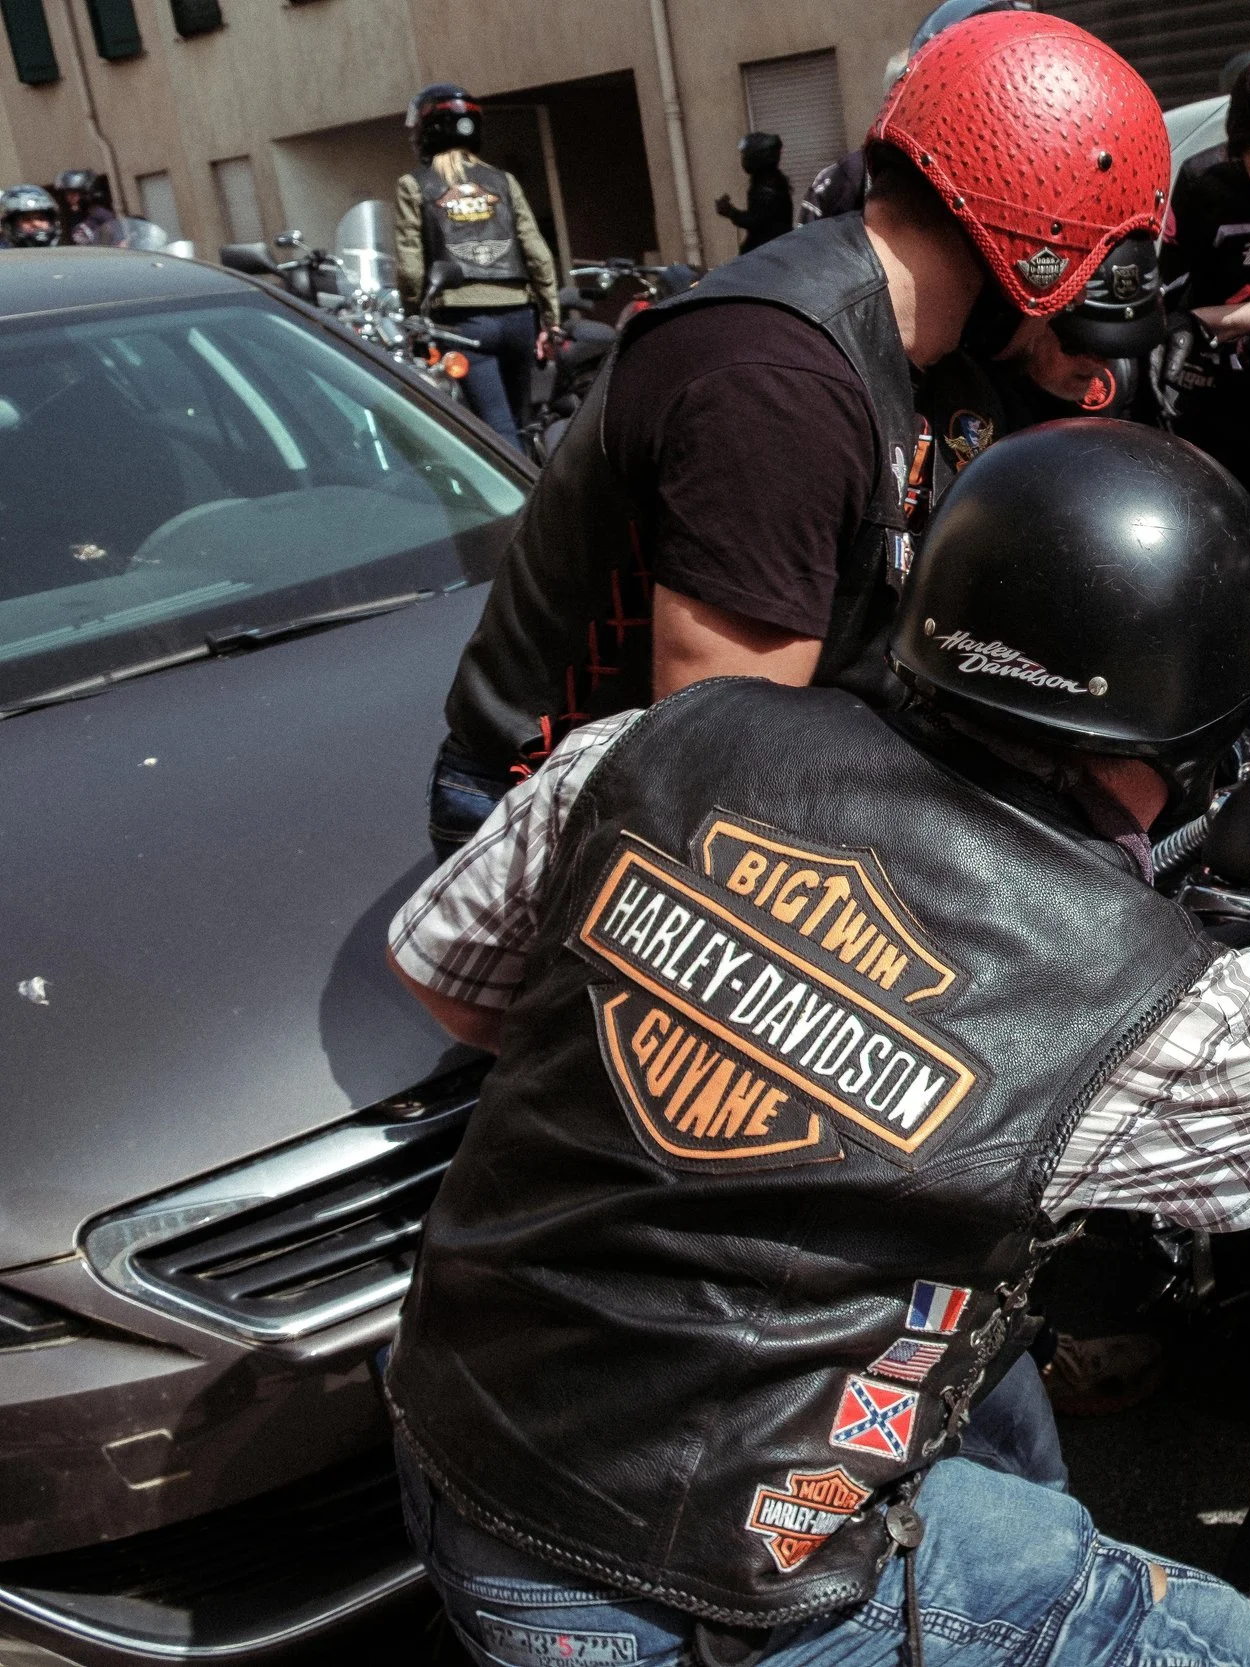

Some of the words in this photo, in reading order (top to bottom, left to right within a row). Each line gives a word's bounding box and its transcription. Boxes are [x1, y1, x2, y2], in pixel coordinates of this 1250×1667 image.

[935, 630, 1022, 662] Harley
[958, 653, 1088, 693] Davidson
[604, 878, 944, 1129] HARLEY-DAVIDSON
[631, 1007, 789, 1139] GUYANE
[799, 1477, 859, 1508] MOTOR
